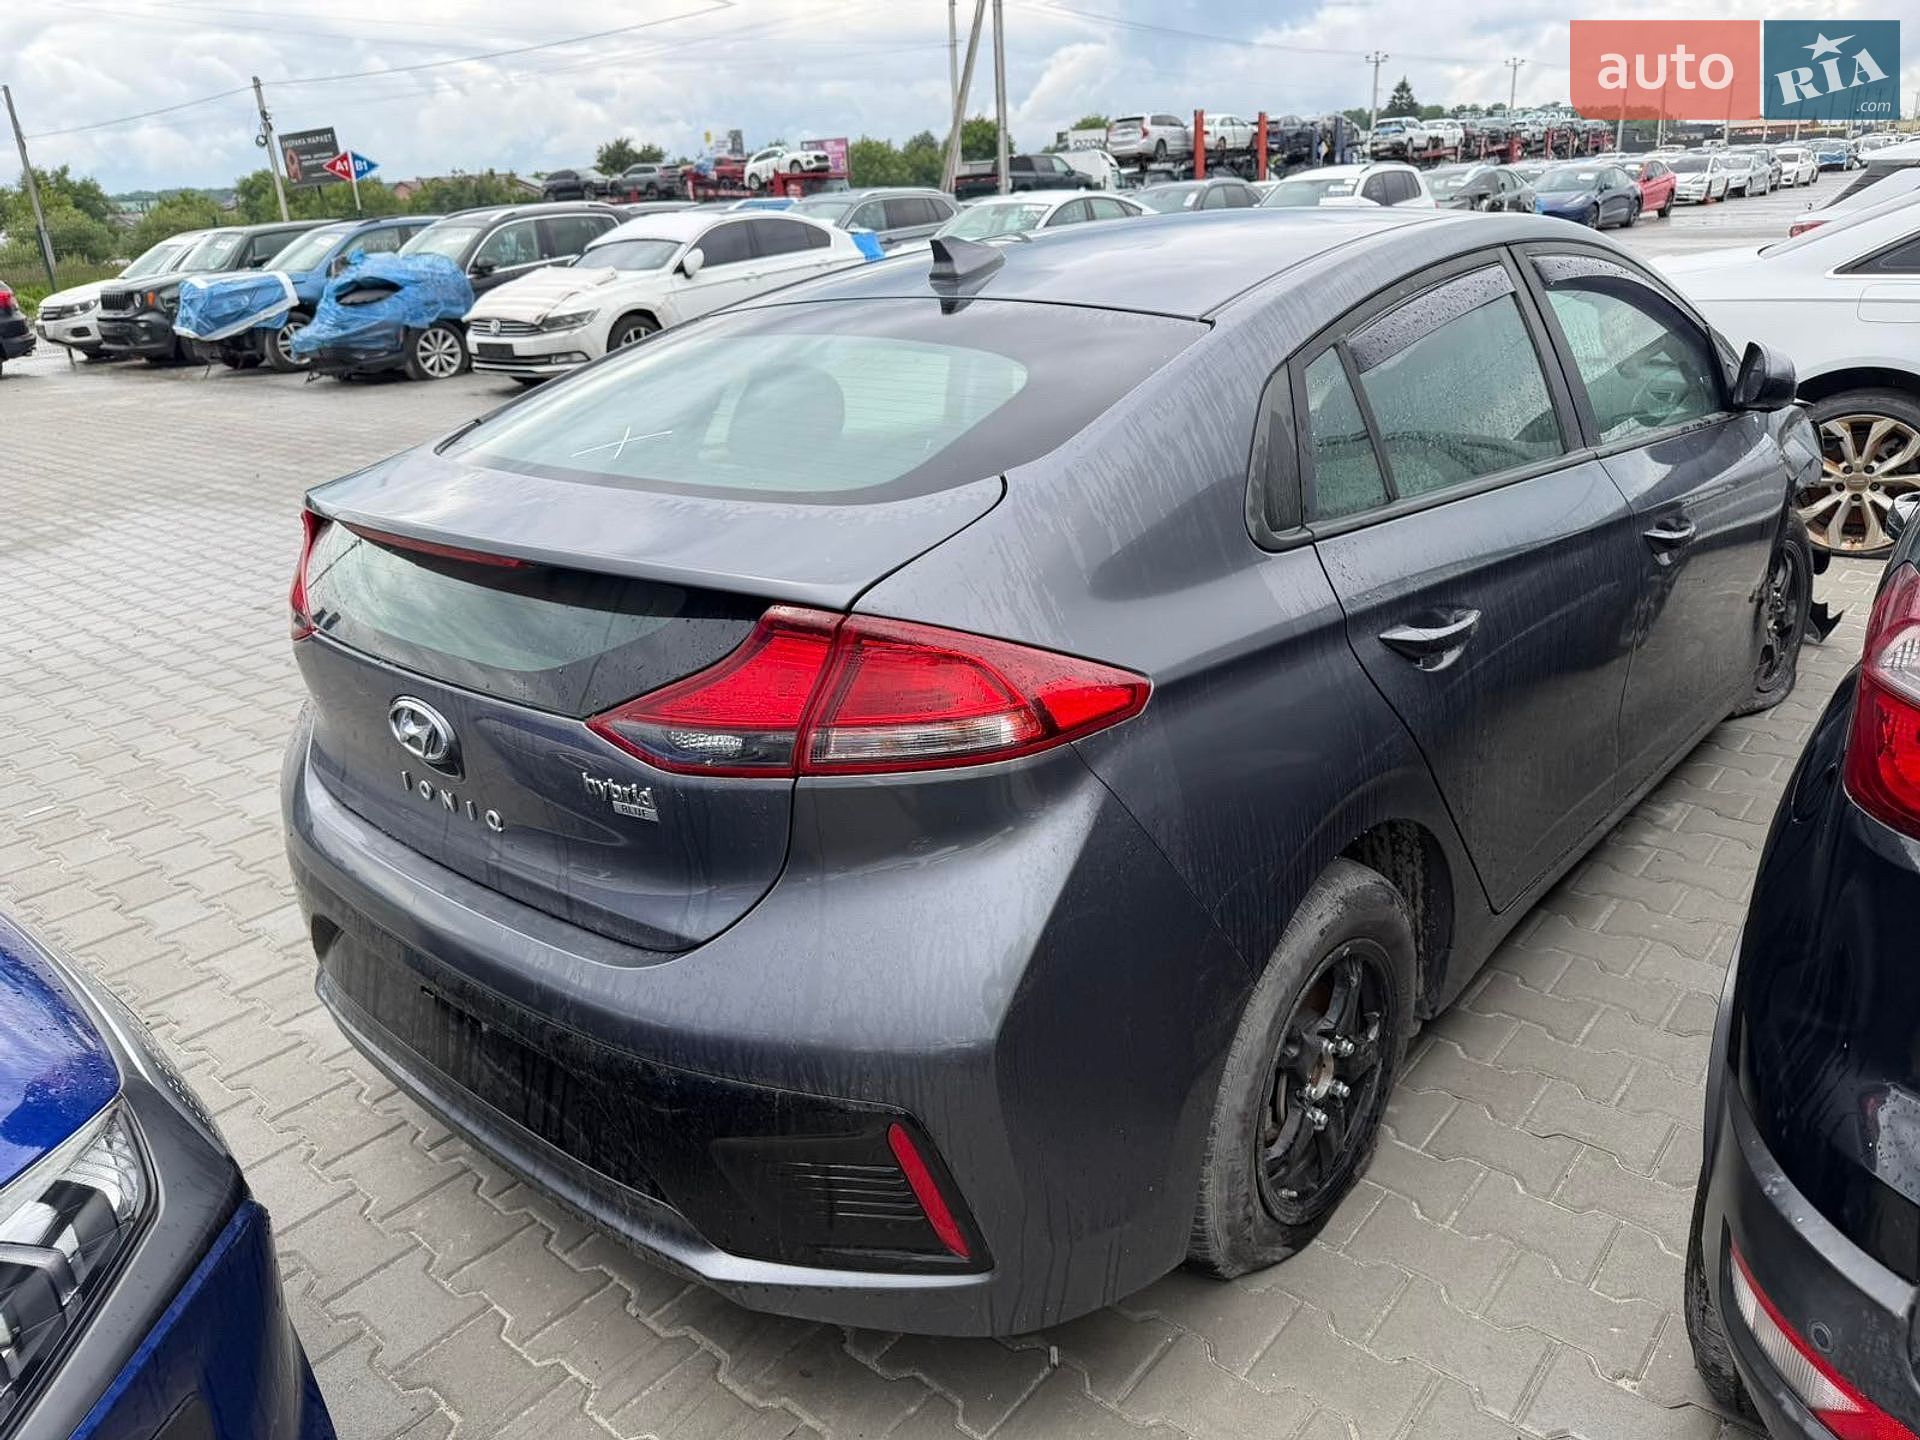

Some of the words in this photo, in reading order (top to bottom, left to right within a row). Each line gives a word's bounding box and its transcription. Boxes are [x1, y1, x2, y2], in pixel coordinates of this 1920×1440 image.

[335, 159, 349, 171] A1
[355, 159, 368, 171] B1
[582, 772, 656, 810] hybrid
[402, 771, 503, 832] IONIQ
[621, 803, 650, 817] BLUE
